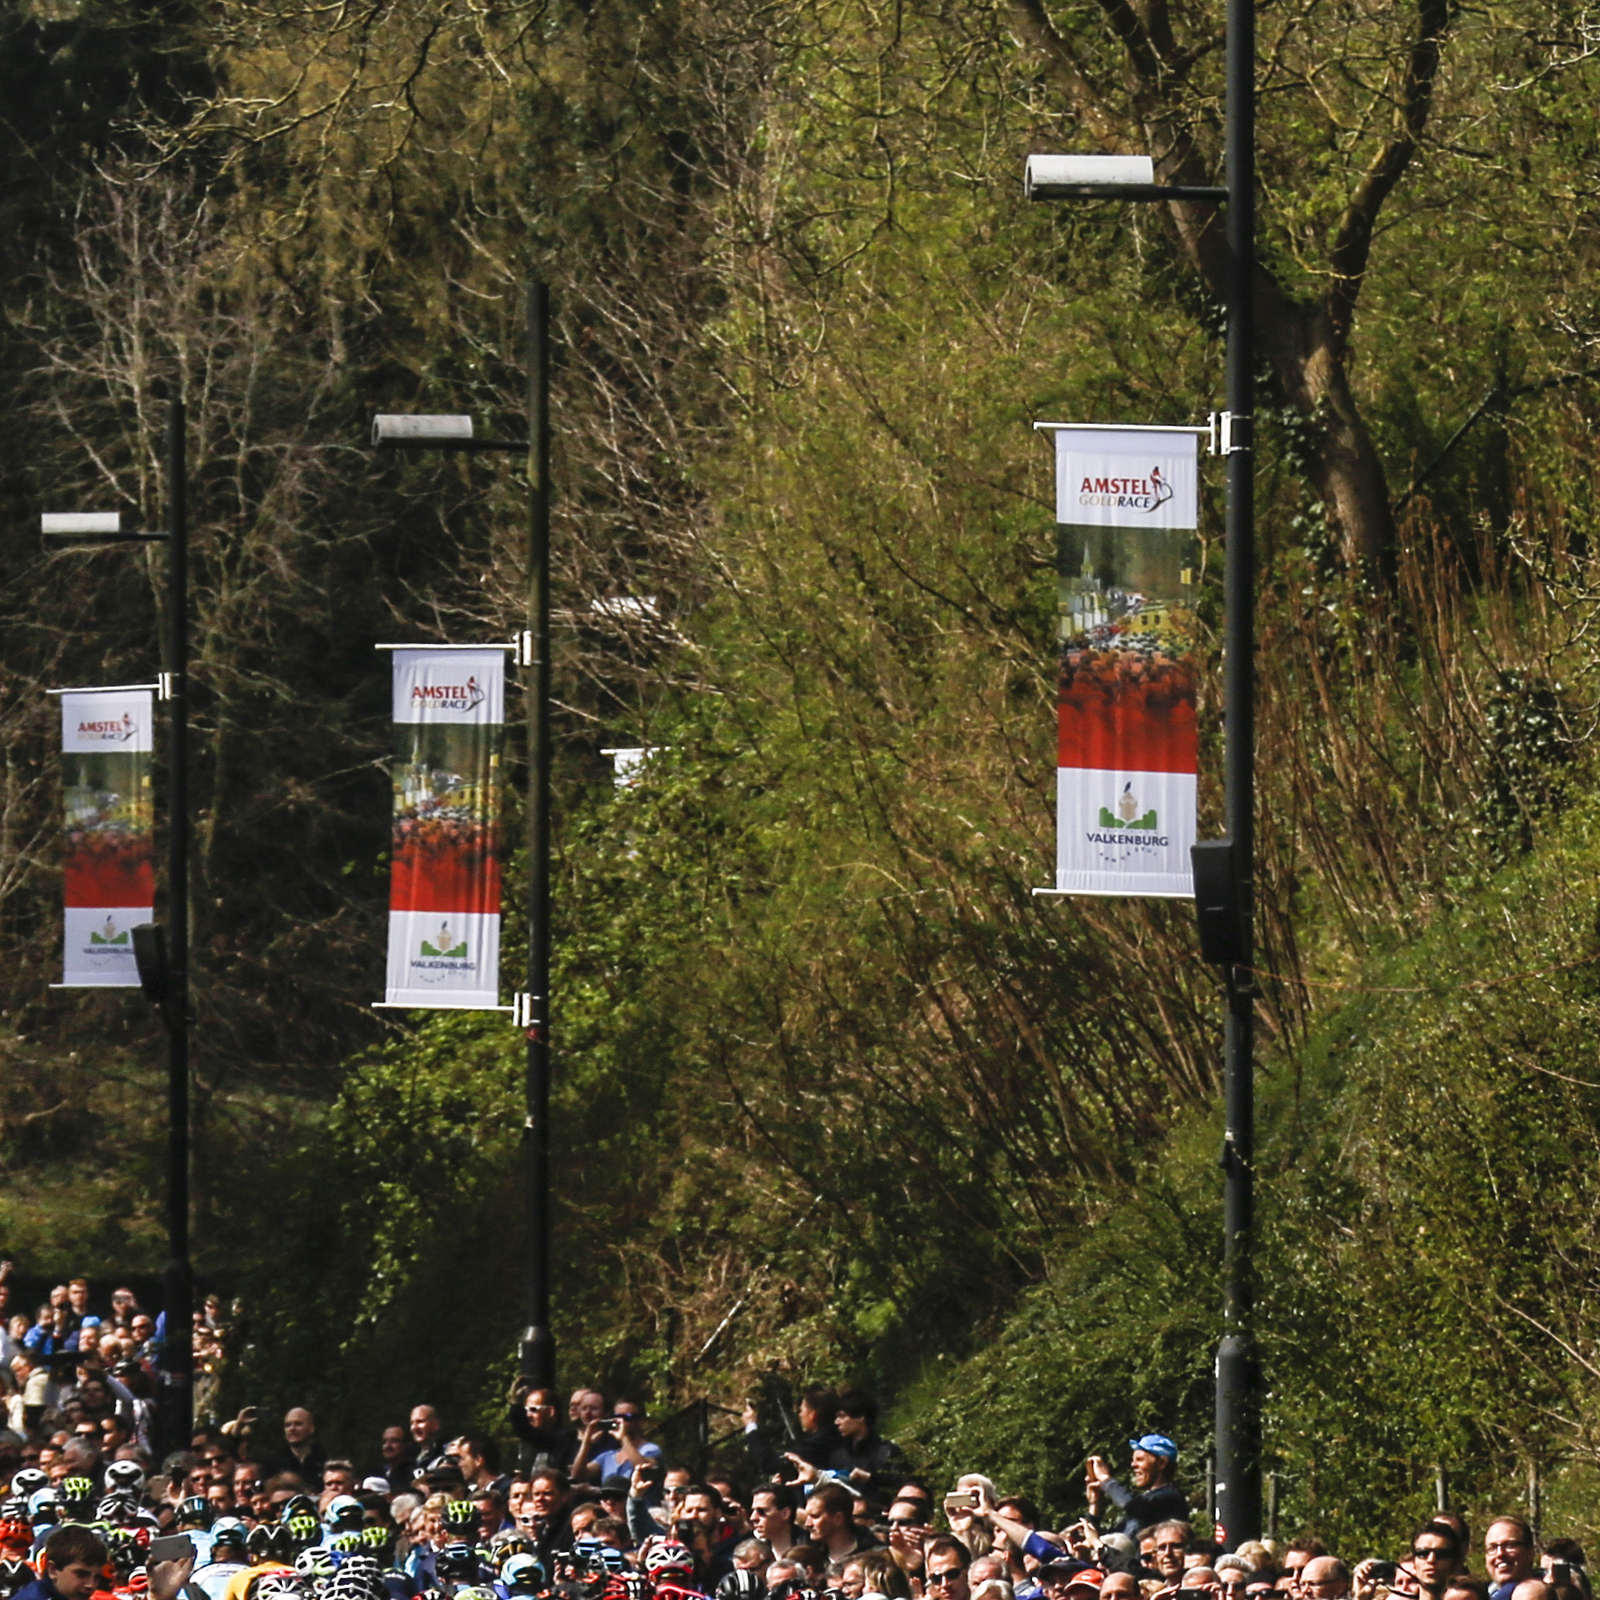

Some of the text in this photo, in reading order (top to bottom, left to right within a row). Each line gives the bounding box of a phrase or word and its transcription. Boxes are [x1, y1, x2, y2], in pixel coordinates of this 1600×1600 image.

[1080, 477, 1152, 495] AMSTEL
[411, 686, 467, 699] AMSTEL
[77, 721, 122, 732] AMSTEL
[1086, 832, 1169, 847] VALKENBURG
[410, 960, 477, 971] VALKENBURG
